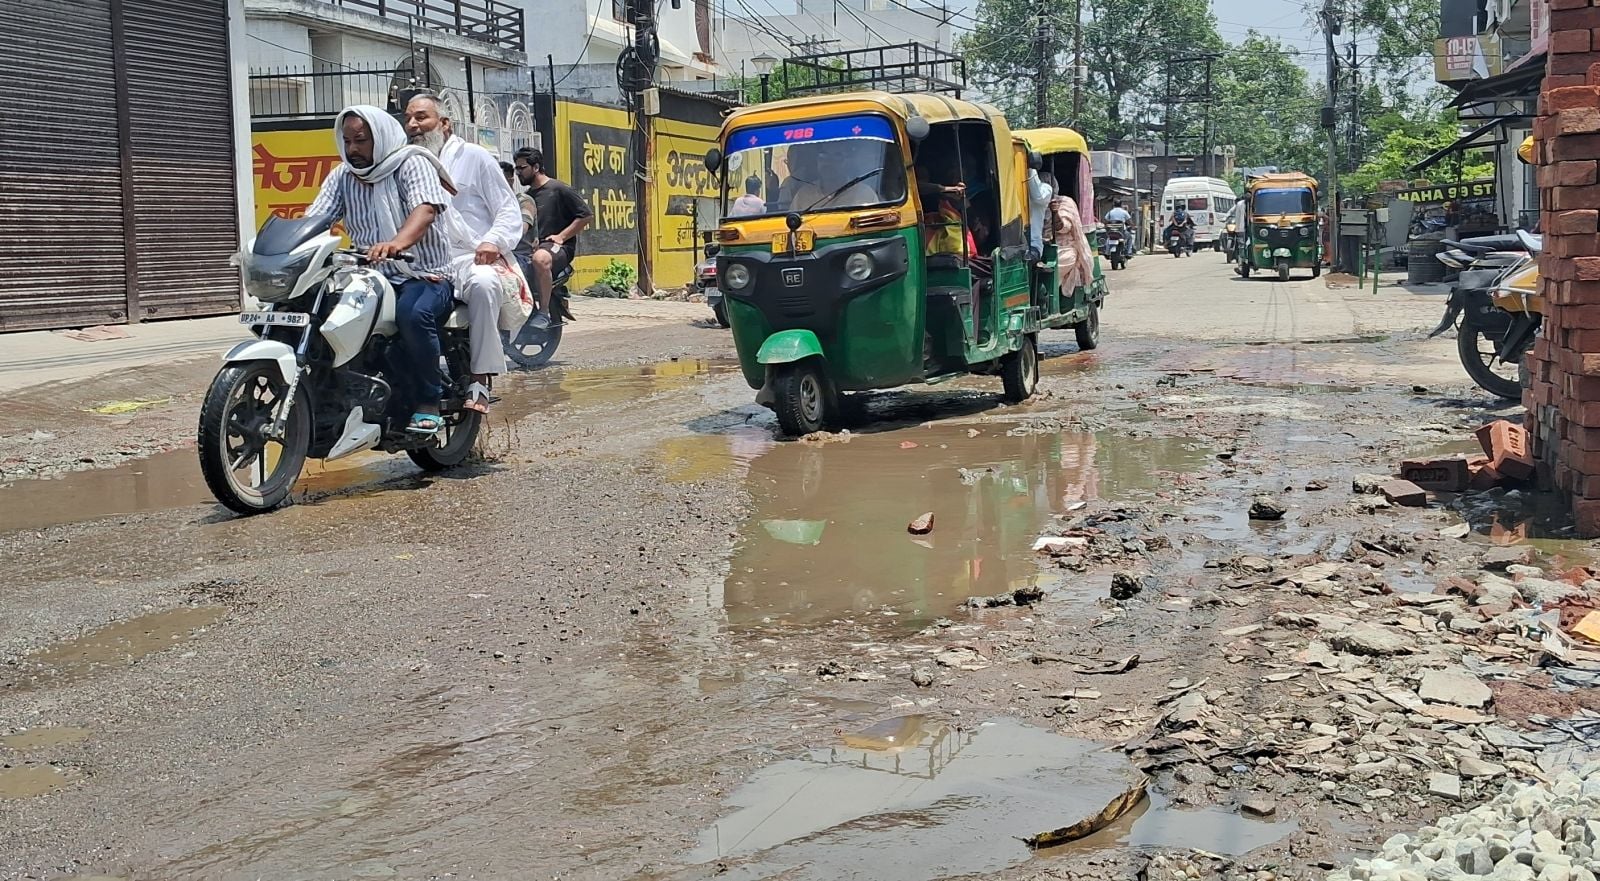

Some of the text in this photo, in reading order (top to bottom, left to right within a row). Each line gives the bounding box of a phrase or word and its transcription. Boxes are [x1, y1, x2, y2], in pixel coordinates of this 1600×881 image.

[784, 127, 814, 140] 786
[583, 132, 626, 176] देश का
[601, 189, 635, 231] सीमेंट
[786, 274, 801, 284] RE
[266, 314, 275, 322] AA
